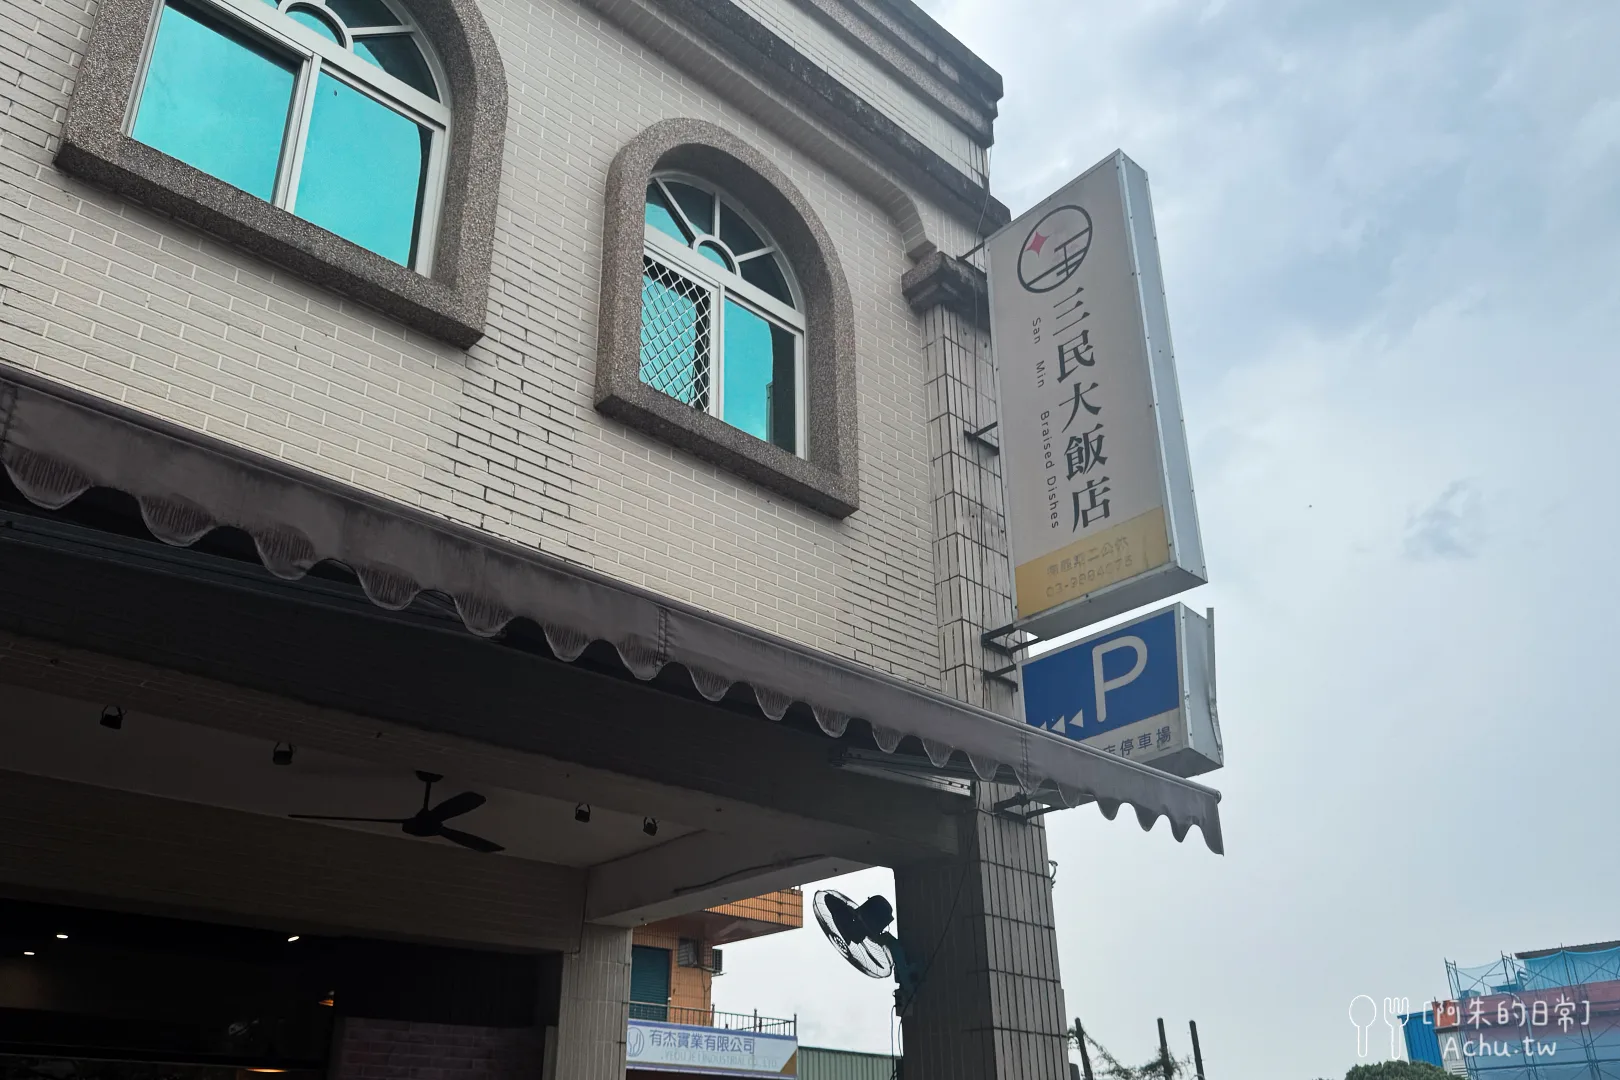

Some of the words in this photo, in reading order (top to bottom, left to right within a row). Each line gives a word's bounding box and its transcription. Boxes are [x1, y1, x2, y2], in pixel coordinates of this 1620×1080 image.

[1032, 317, 1042, 345] San
[1036, 360, 1046, 388] Min
[1052, 286, 1111, 533] 三民大飯店
[1040, 410, 1055, 469] Braised
[1046, 475, 1059, 529] Dishes
[1092, 635, 1148, 722] P
[649, 1029, 755, 1055] 有杰實業有限公司
